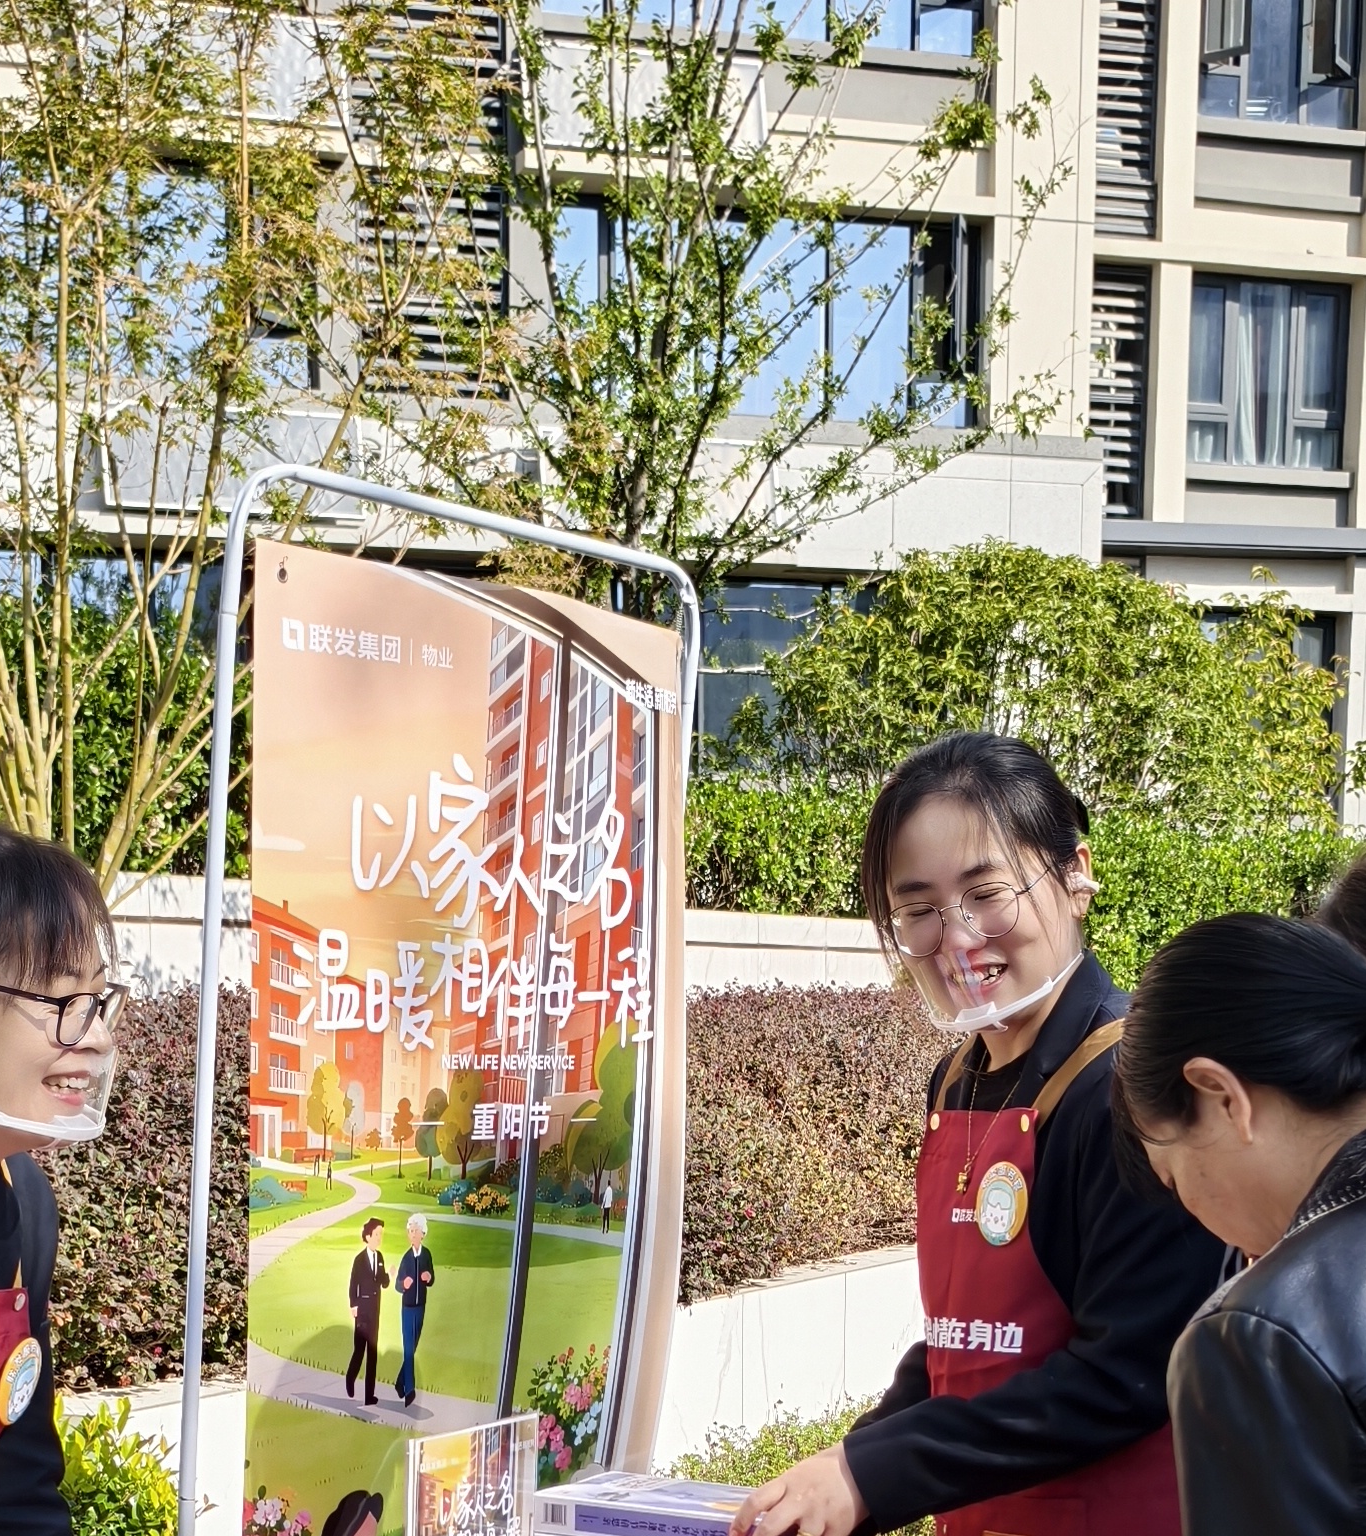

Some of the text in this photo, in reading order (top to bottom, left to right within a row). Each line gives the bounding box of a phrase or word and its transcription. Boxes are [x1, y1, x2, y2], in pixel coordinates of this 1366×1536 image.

[308, 623, 454, 669] 联发集团 物业
[351, 754, 633, 930] 以家人之名
[292, 929, 655, 1051] 温暖相伴每一程
[441, 1054, 576, 1070] NEW LIFE NEW SERVICE
[471, 1101, 552, 1141] 重阳节
[439, 1470, 515, 1528] 以家人之名
